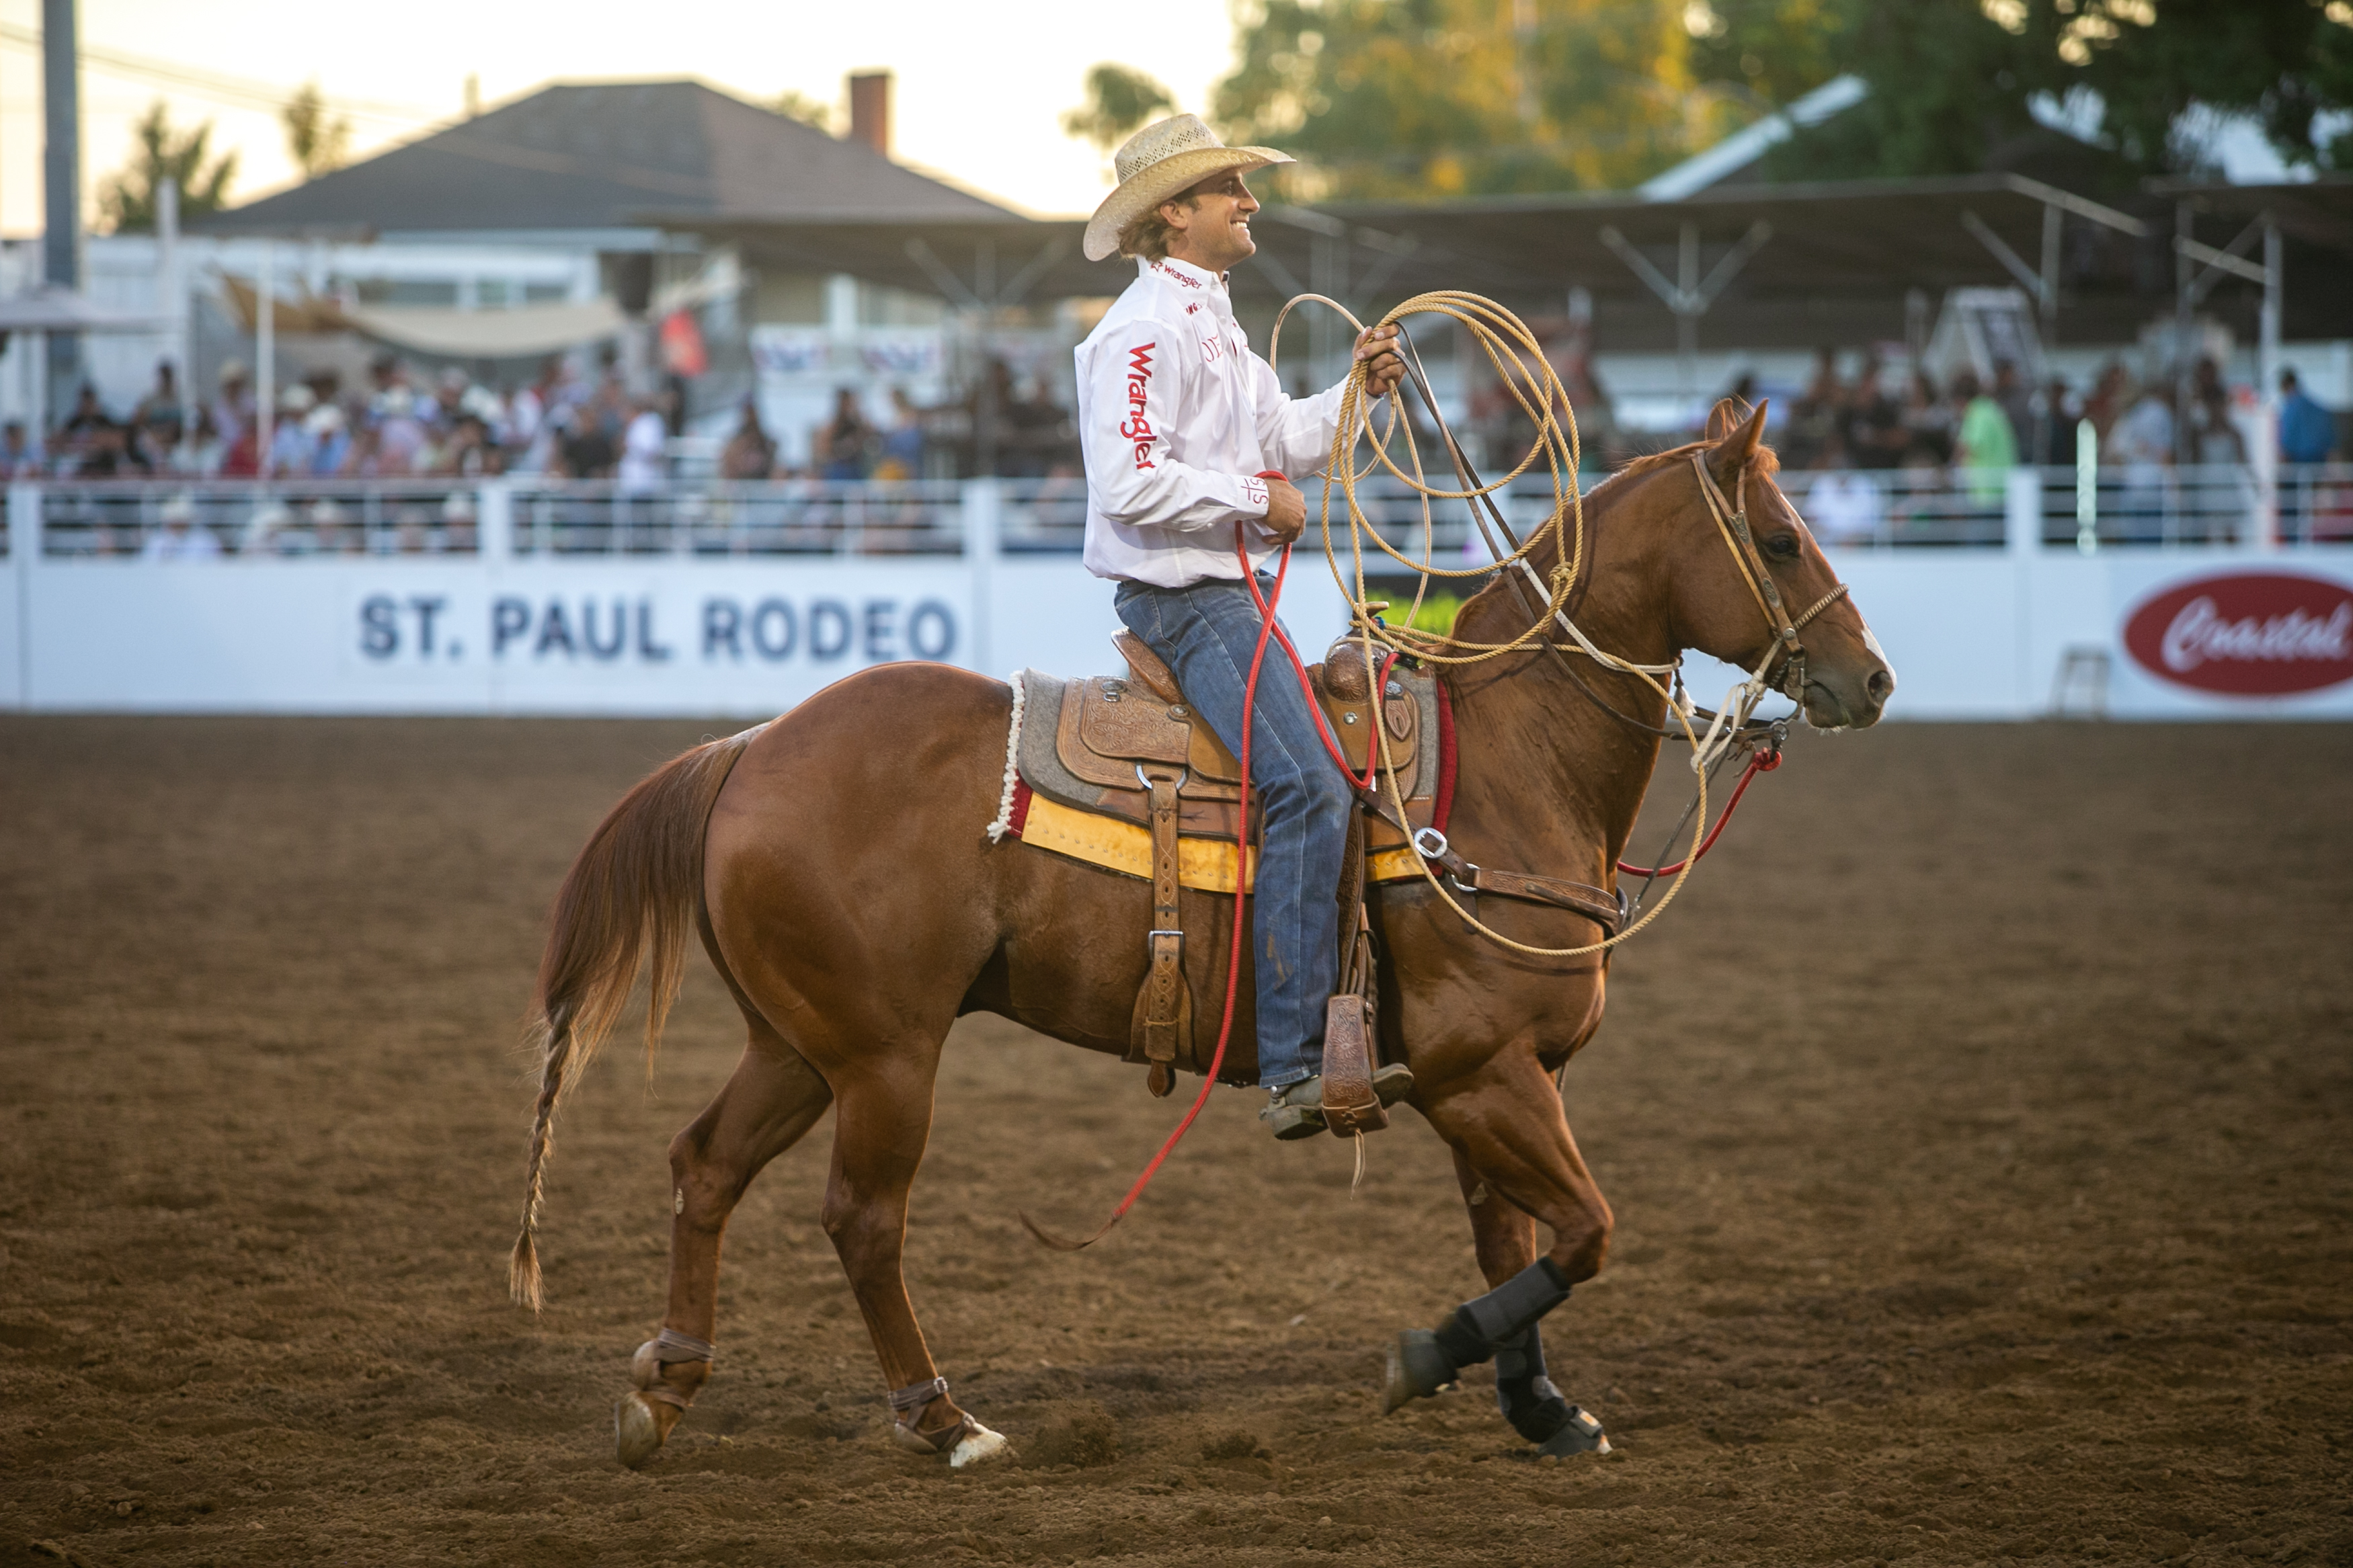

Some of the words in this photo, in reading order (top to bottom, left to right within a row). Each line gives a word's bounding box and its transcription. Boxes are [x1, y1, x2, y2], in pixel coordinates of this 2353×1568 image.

[1164, 264, 1203, 290] Wrangler
[1121, 341, 1156, 470] Wrangler
[360, 593, 464, 662] ST.
[492, 593, 672, 662] PAUL
[701, 594, 957, 663] RODEO
